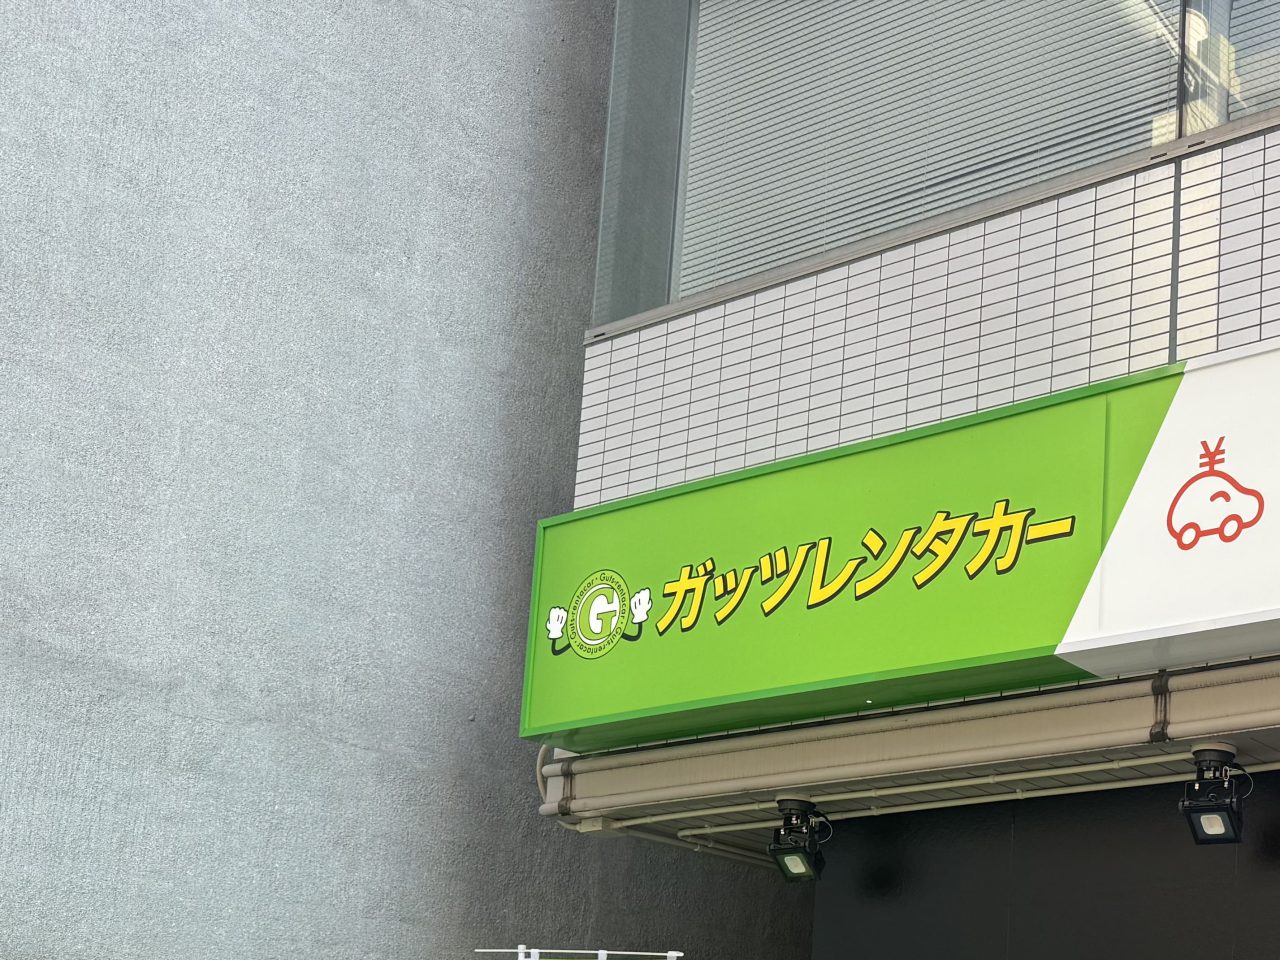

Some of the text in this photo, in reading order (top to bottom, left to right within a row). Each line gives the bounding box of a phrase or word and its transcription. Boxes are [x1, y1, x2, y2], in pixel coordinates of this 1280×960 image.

[656, 499, 1075, 635] ガッツレンタカー
